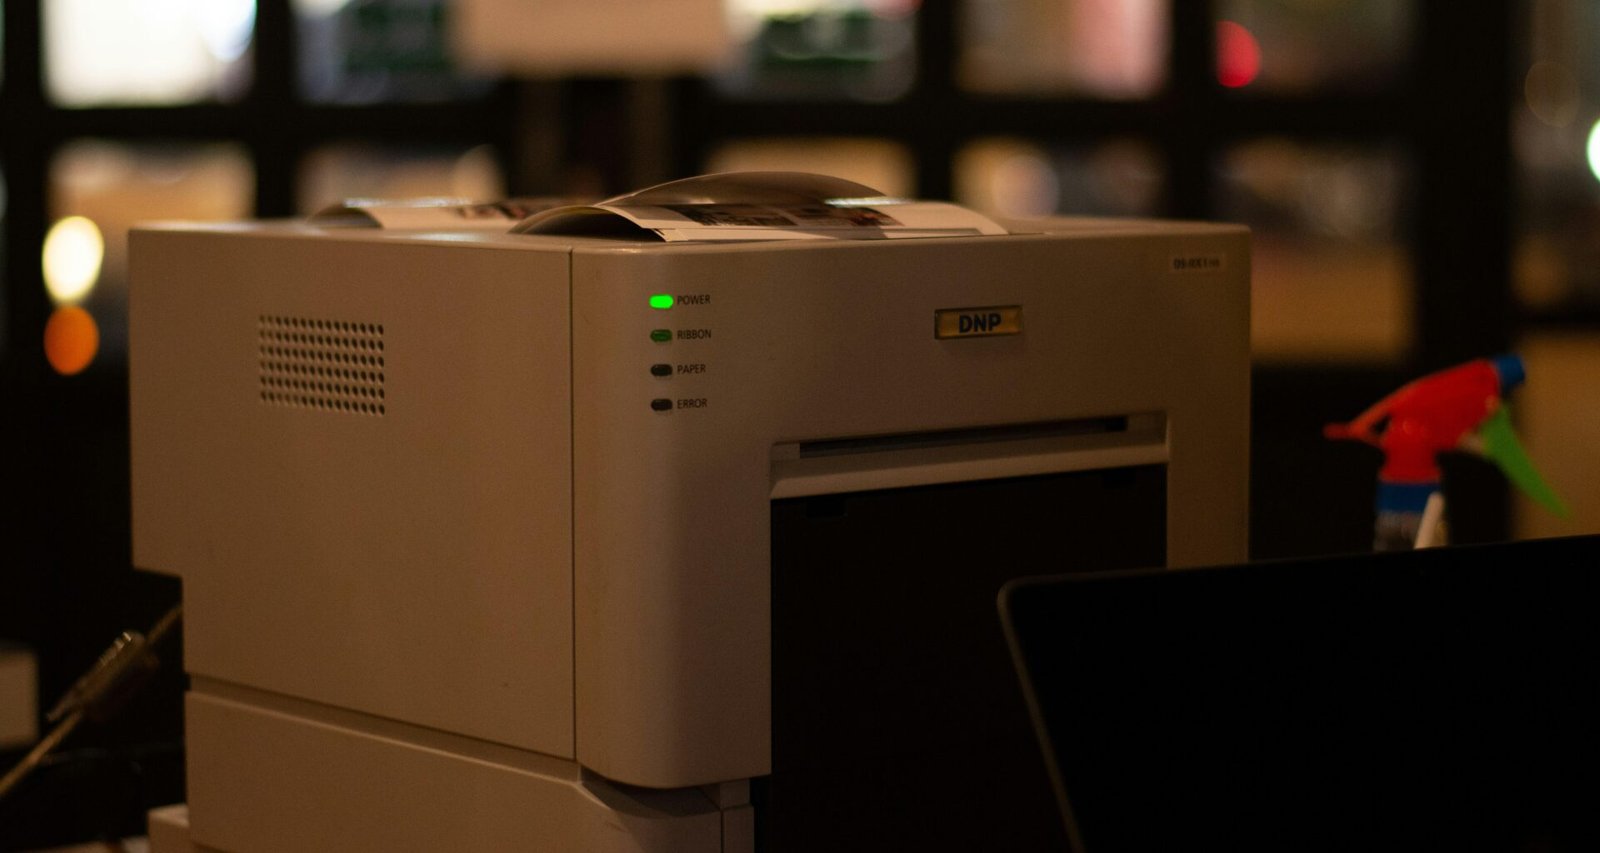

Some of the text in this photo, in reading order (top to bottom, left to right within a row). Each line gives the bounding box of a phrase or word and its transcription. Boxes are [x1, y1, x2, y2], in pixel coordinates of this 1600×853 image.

[677, 294, 711, 305] POWER
[959, 313, 1001, 332] DNP
[677, 329, 712, 340] RIBBON
[677, 363, 707, 375] PAPER
[677, 398, 708, 409] ERROR
